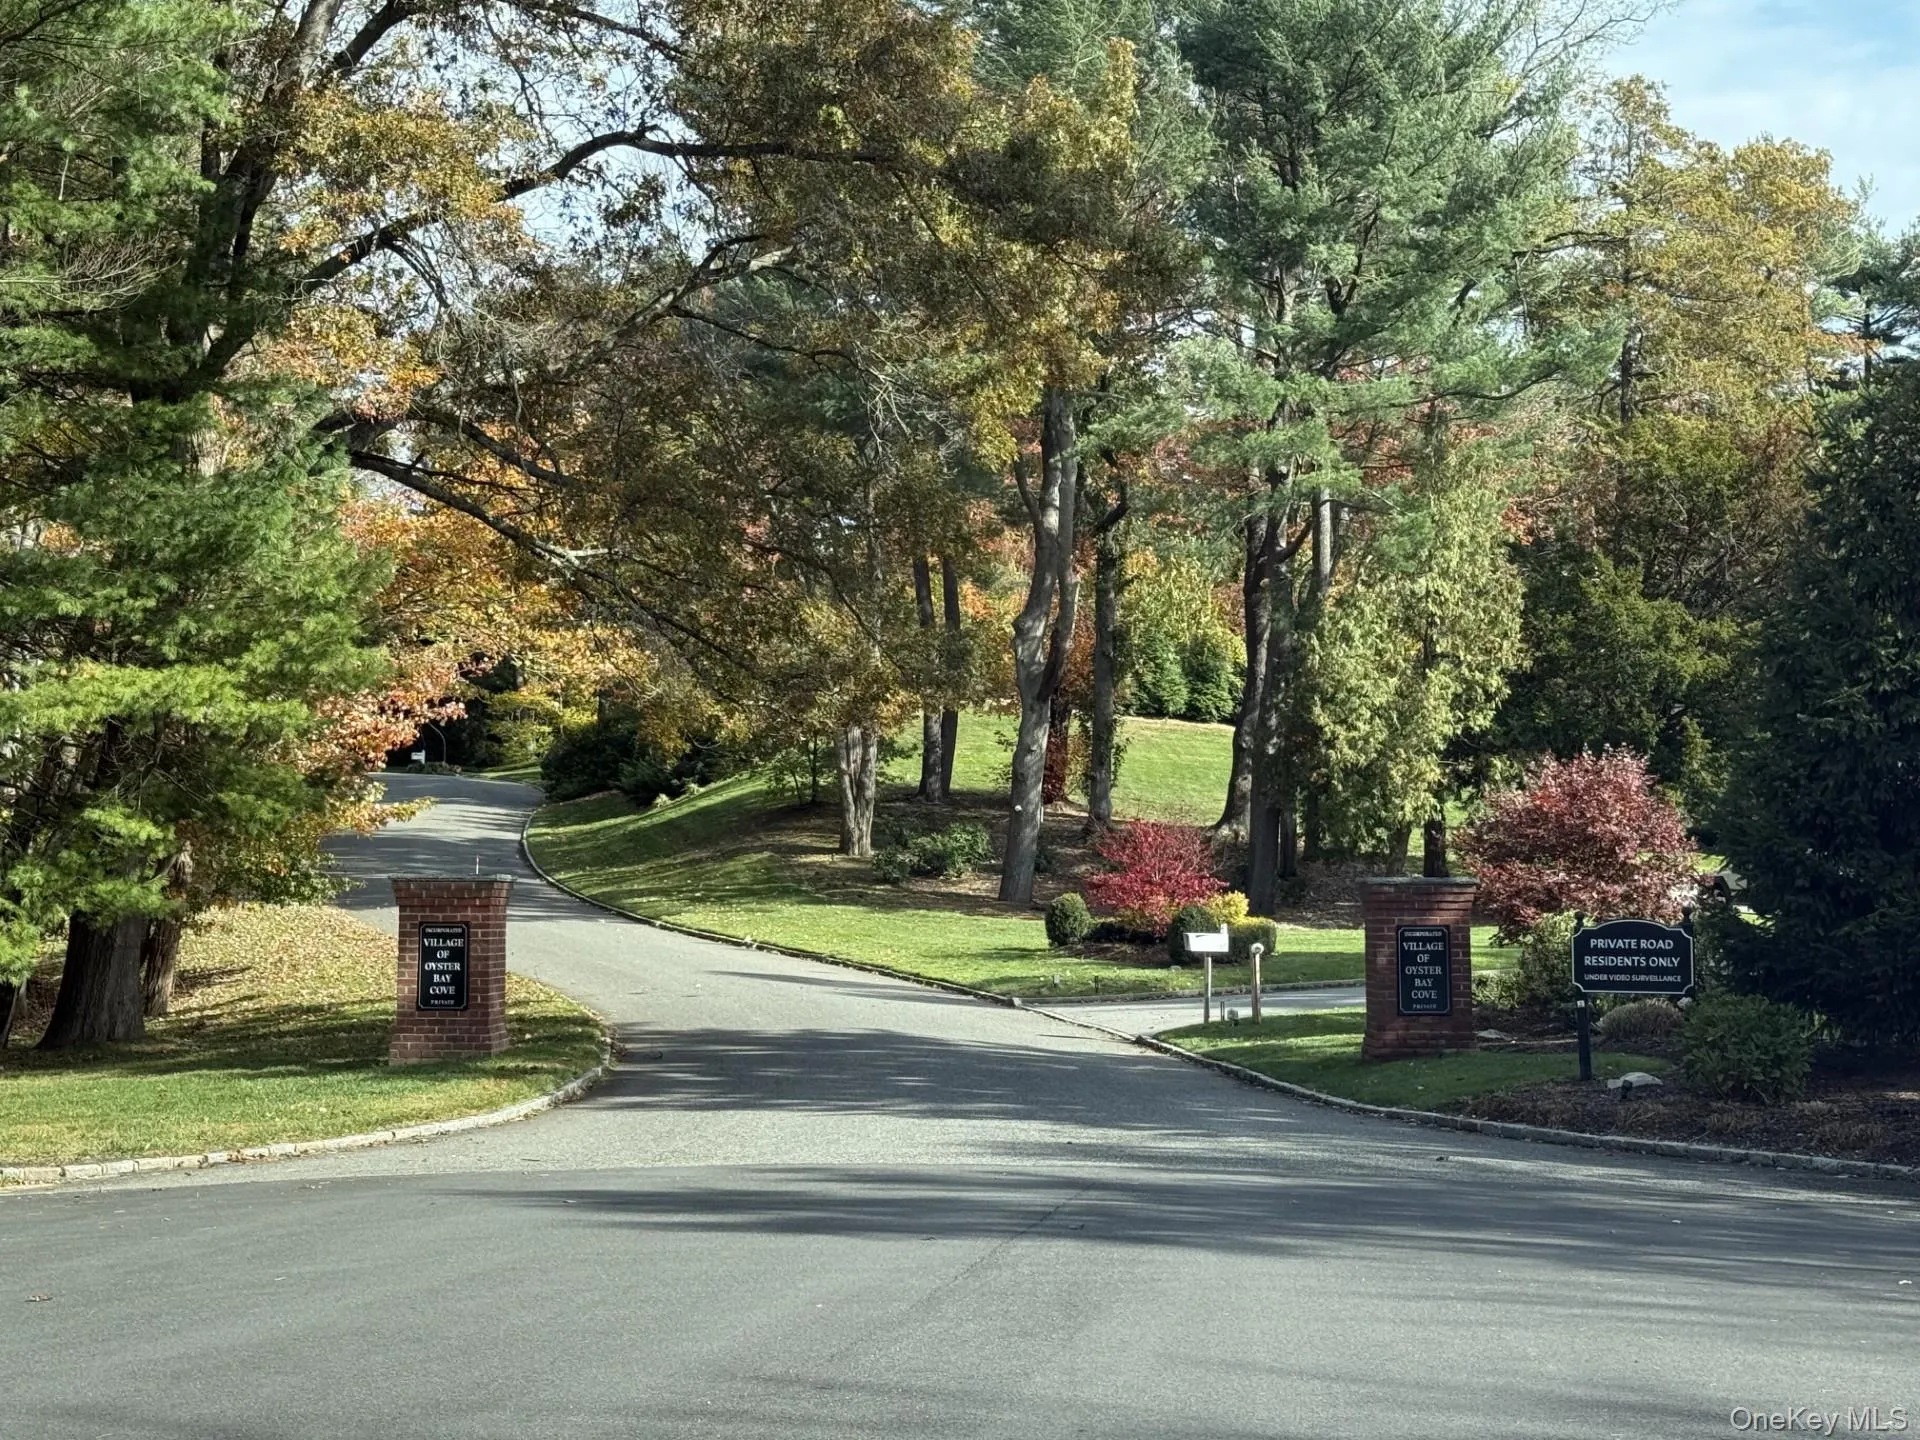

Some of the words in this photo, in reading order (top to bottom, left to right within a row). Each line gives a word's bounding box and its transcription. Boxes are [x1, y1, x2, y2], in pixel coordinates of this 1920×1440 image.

[423, 938, 464, 947] VILLAGE
[1402, 942, 1445, 951] VILLAGE
[1590, 938, 1637, 949] PRIVATE
[1640, 939, 1674, 950] ROAD
[436, 950, 450, 959] OF
[1416, 954, 1430, 963] OF
[1584, 955, 1646, 967] RESIDENTS
[1649, 956, 1681, 967] ONLY
[424, 962, 461, 971] OYSTER
[1405, 966, 1442, 975] OYSTER
[433, 974, 452, 983] BAY
[1584, 973, 1608, 981] UNDER
[1631, 974, 1681, 982] SURVEILLANCE
[1414, 978, 1434, 987] BAY
[429, 986, 456, 995] COVE
[1411, 990, 1438, 999] COVE
